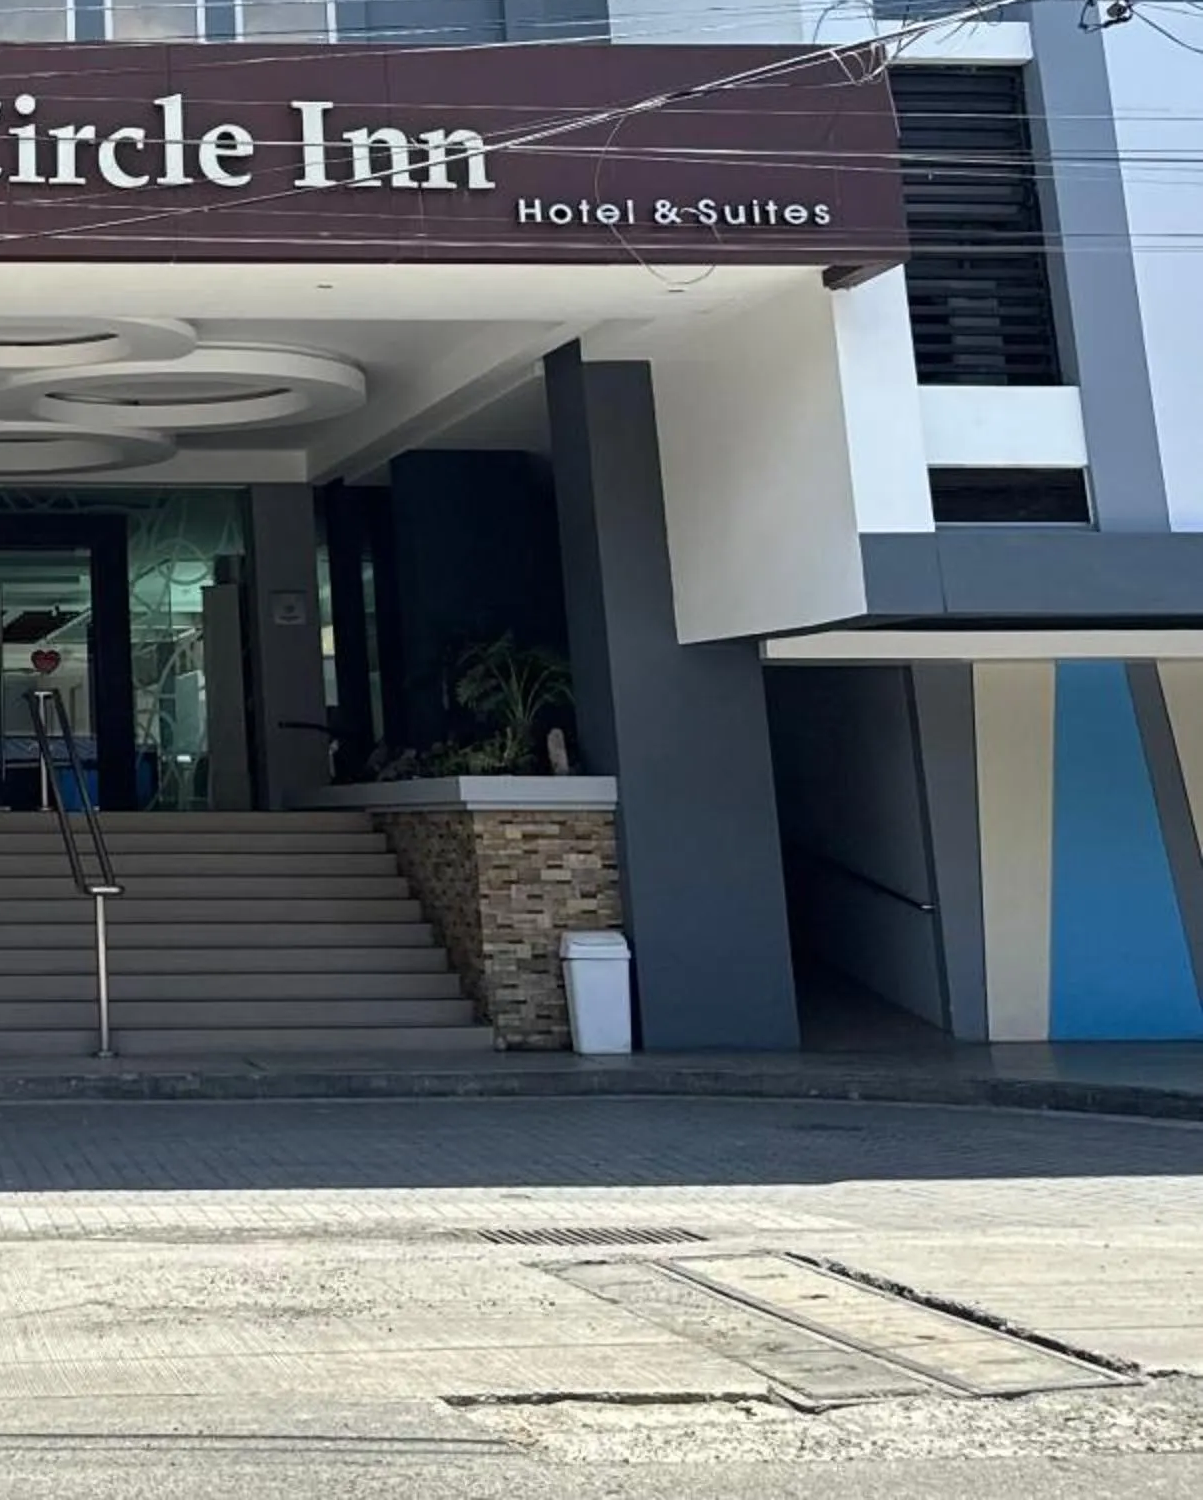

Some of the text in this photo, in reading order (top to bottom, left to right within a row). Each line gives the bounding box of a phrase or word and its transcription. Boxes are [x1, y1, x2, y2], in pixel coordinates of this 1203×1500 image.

[290, 100, 497, 190] Inn
[518, 198, 831, 225] Hotel & Suites
